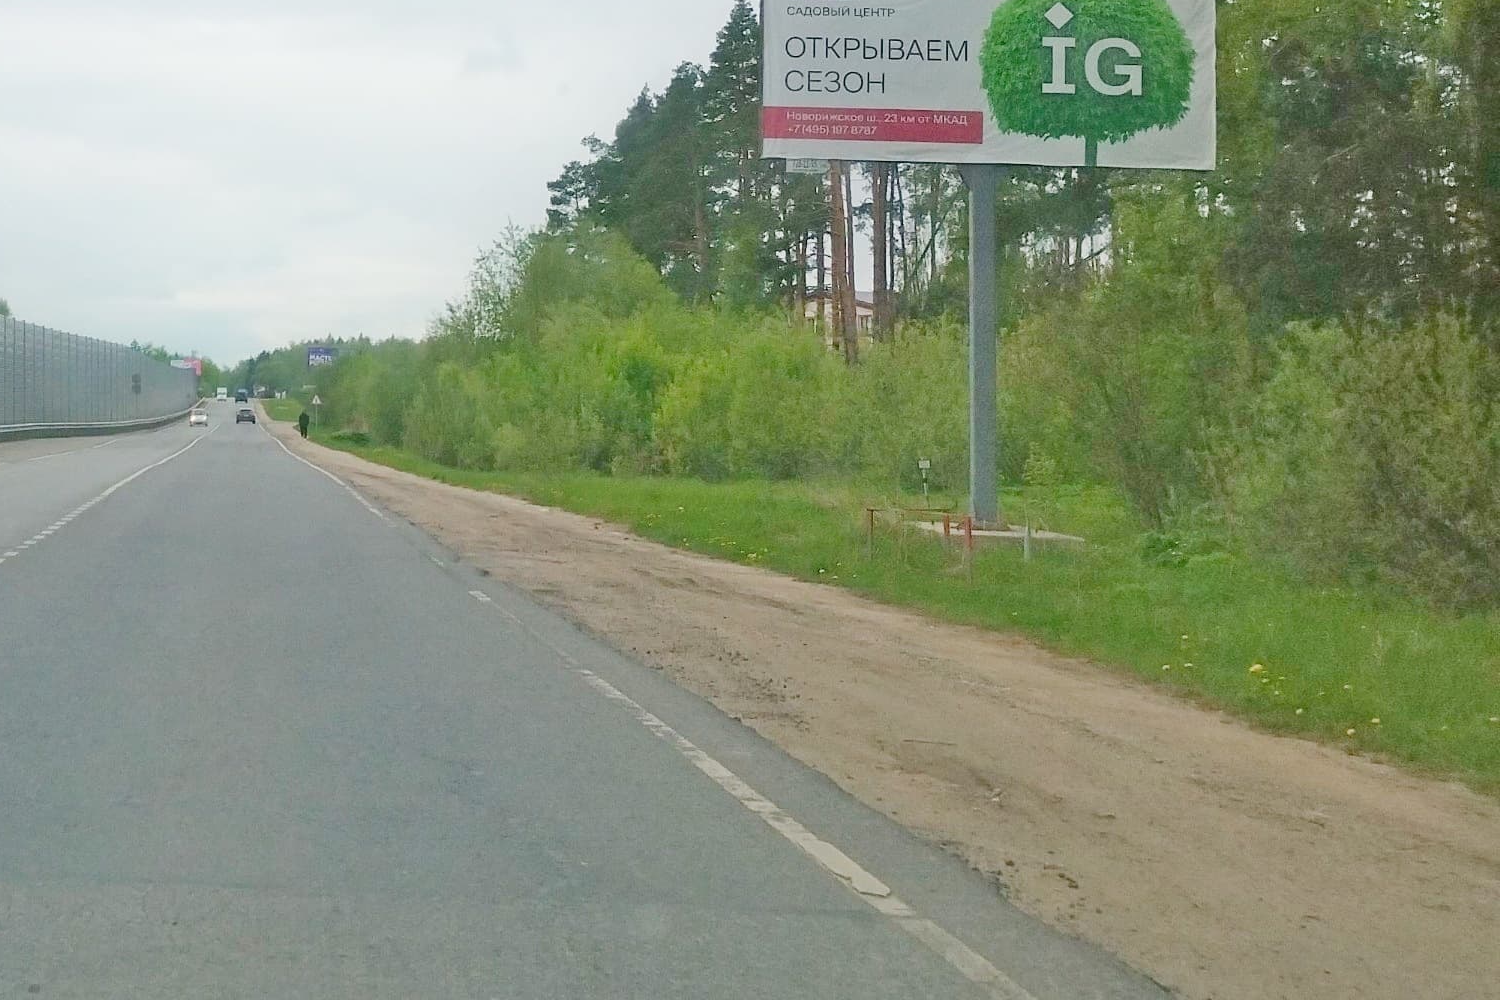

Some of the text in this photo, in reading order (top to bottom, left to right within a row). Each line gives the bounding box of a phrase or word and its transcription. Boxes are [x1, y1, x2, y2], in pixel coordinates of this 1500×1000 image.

[786, 6, 896, 19] САДОВЫЙ ЦЕНТР
[784, 36, 969, 63] ОТКРЫВАЕМ
[784, 69, 886, 94] СЕЗОН
[786, 111, 864, 123] Новорижское
[884, 113, 898, 124] 23
[900, 115, 915, 124] км
[917, 116, 930, 125] от
[932, 114, 968, 126] МКАД
